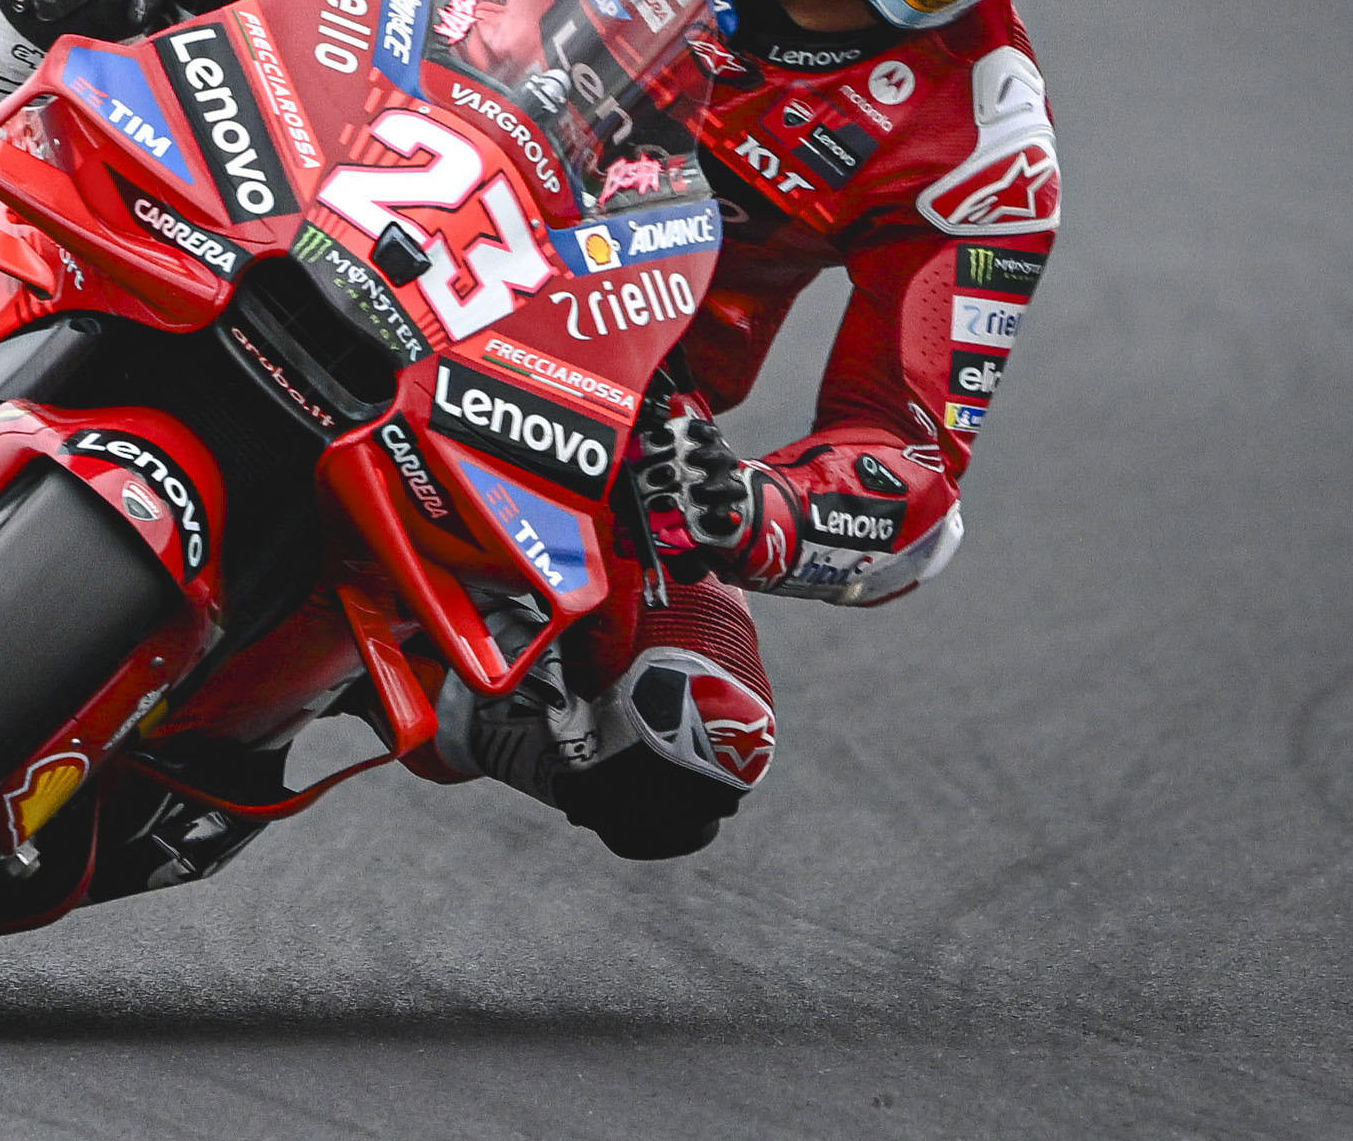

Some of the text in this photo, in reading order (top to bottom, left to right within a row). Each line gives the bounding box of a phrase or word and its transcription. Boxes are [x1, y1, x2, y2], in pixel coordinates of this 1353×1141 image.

[238, 9, 322, 170] FRECCIAROSSA
[768, 44, 862, 68] Lenovo
[108, 98, 173, 158] TIM
[169, 27, 275, 215] Lenovo
[450, 83, 562, 195] VARGROUP
[840, 83, 893, 132] motorola
[734, 135, 816, 195] KYT
[812, 126, 856, 168] Lenovo
[134, 198, 238, 274] CARRERA
[317, 108, 555, 342] 23
[628, 210, 716, 256] ADVANCE
[325, 249, 423, 362] MONSTER
[231, 327, 336, 429] aruba.it
[485, 339, 636, 409] FRECCIAROSSA
[435, 366, 609, 477] Lenovo
[77, 433, 204, 568] Lenovo
[381, 424, 448, 519] CARRERA
[518, 519, 564, 589] TIM
[811, 503, 894, 541] Lenovo
